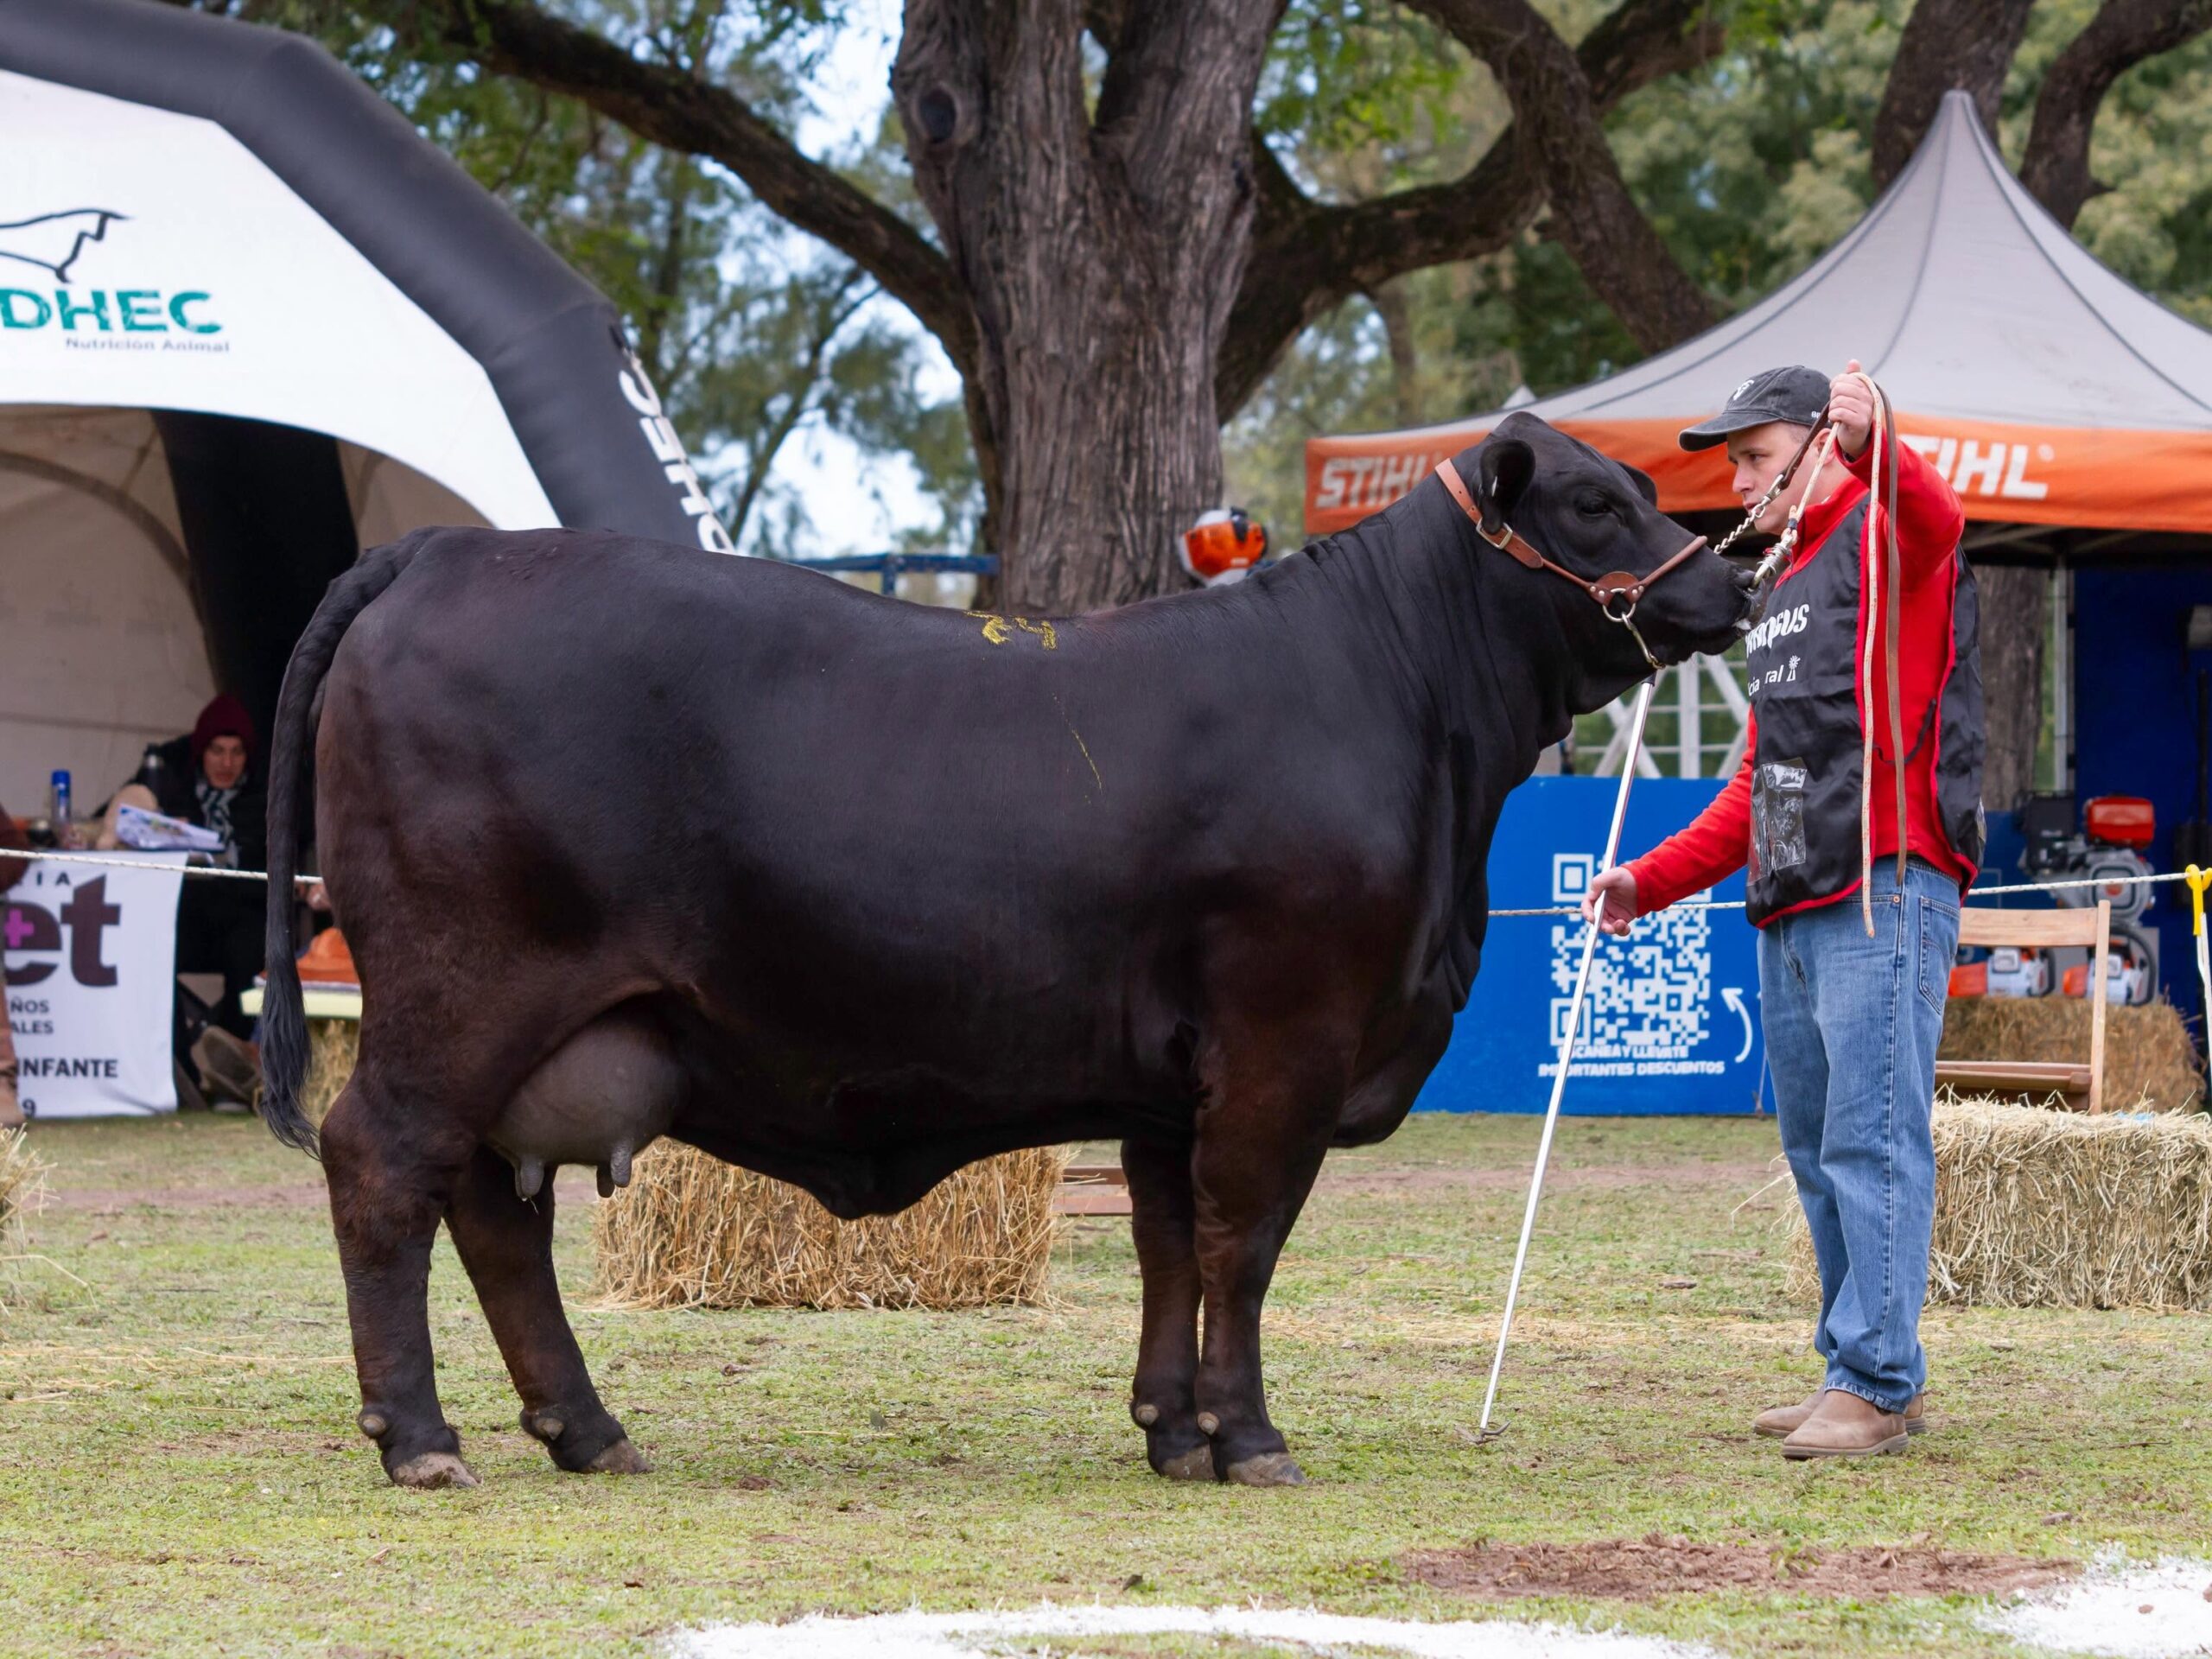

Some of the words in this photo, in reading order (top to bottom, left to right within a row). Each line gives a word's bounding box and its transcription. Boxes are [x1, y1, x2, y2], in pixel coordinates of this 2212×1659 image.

[0, 289, 222, 334] DHEC
[66, 337, 156, 351] Nutrición
[162, 338, 230, 353] Animal
[10, 996, 50, 1014] ÑOS
[1538, 1063, 1635, 1077] IMORTANTES
[1637, 1060, 1726, 1077] DESCUENTOS
